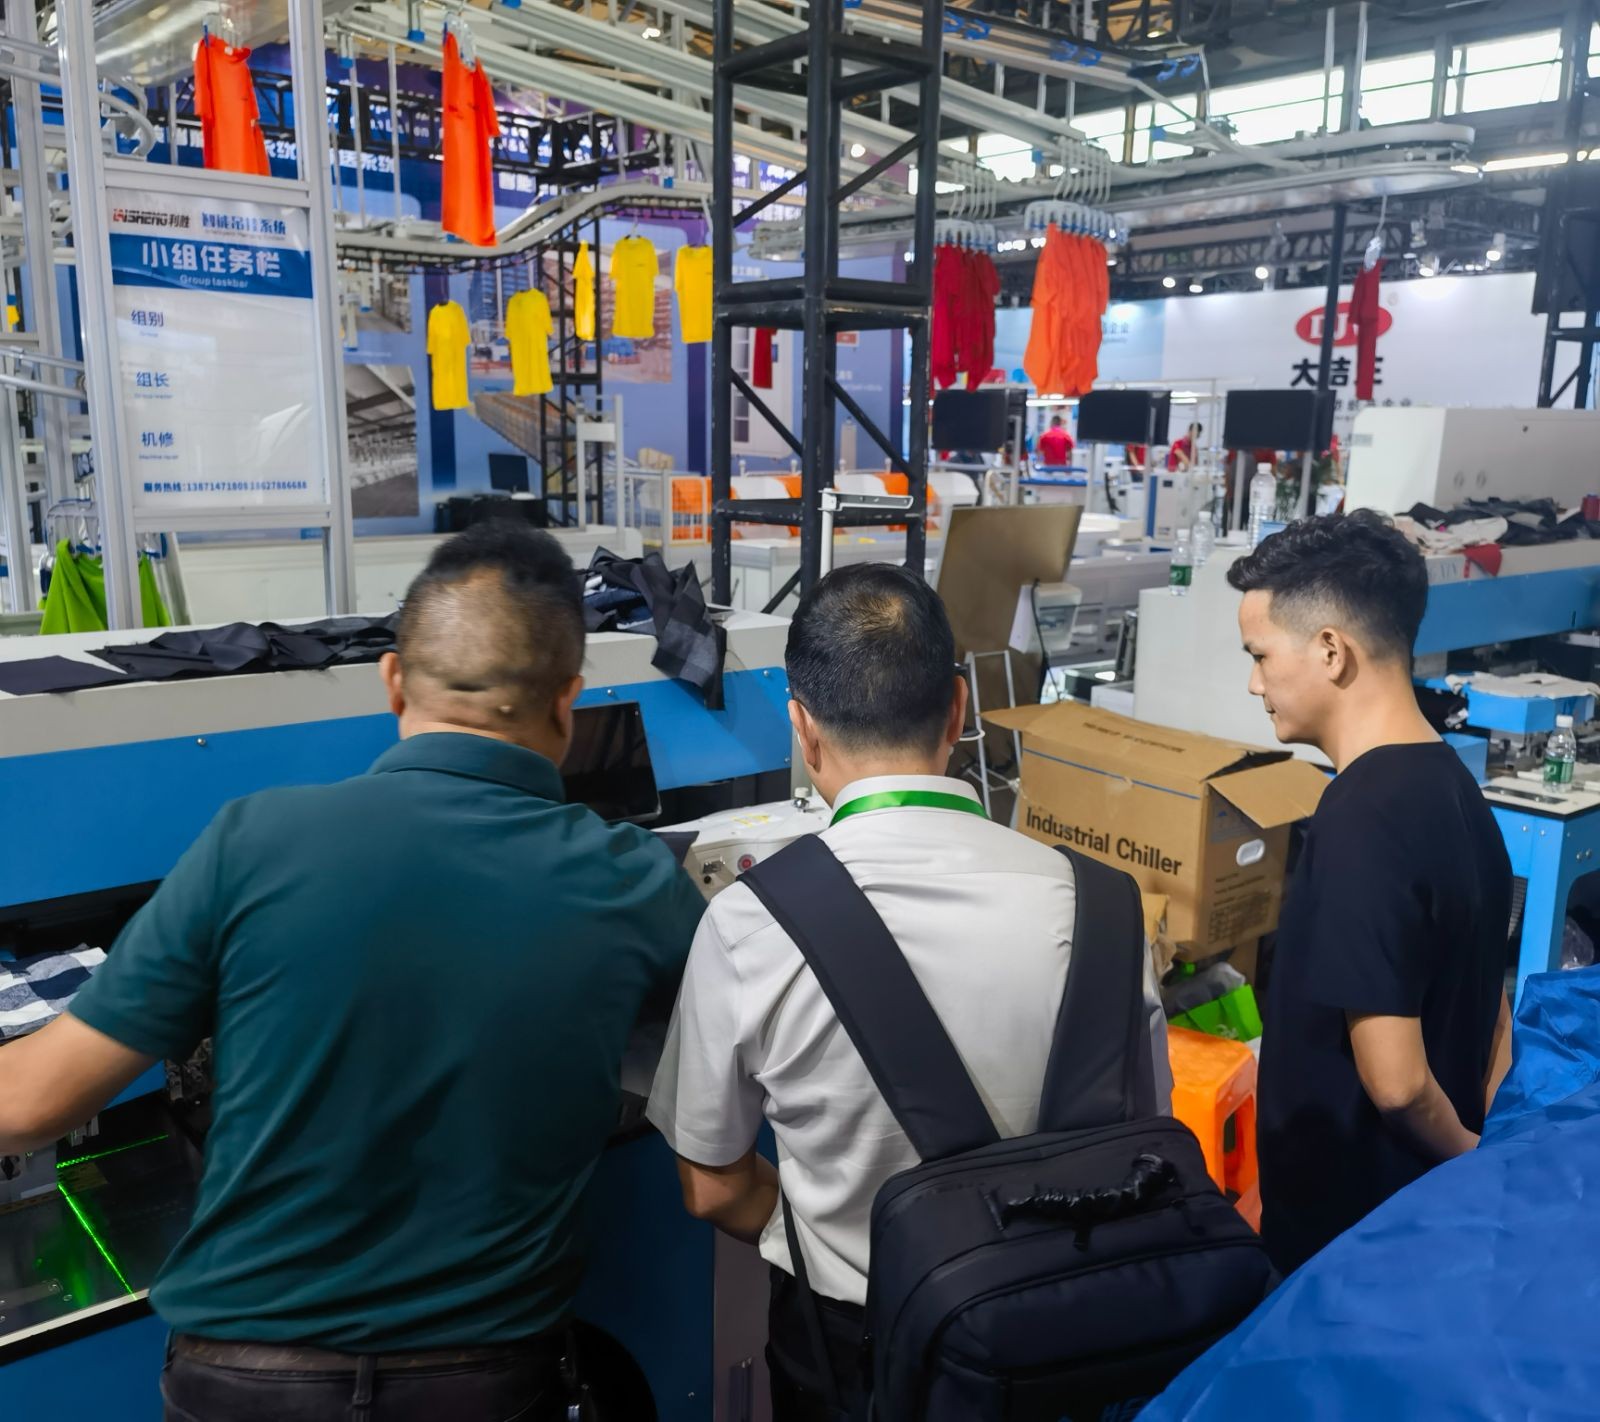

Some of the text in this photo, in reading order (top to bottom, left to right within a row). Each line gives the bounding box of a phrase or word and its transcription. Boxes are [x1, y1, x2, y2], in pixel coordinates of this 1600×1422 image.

[142, 240, 282, 278] 小组任务栏
[179, 274, 249, 289] Group taskbar
[131, 310, 164, 328] 组别
[136, 371, 171, 388] 组长
[141, 431, 175, 448] 机修
[1025, 806, 1183, 876] Industrial Chiller
